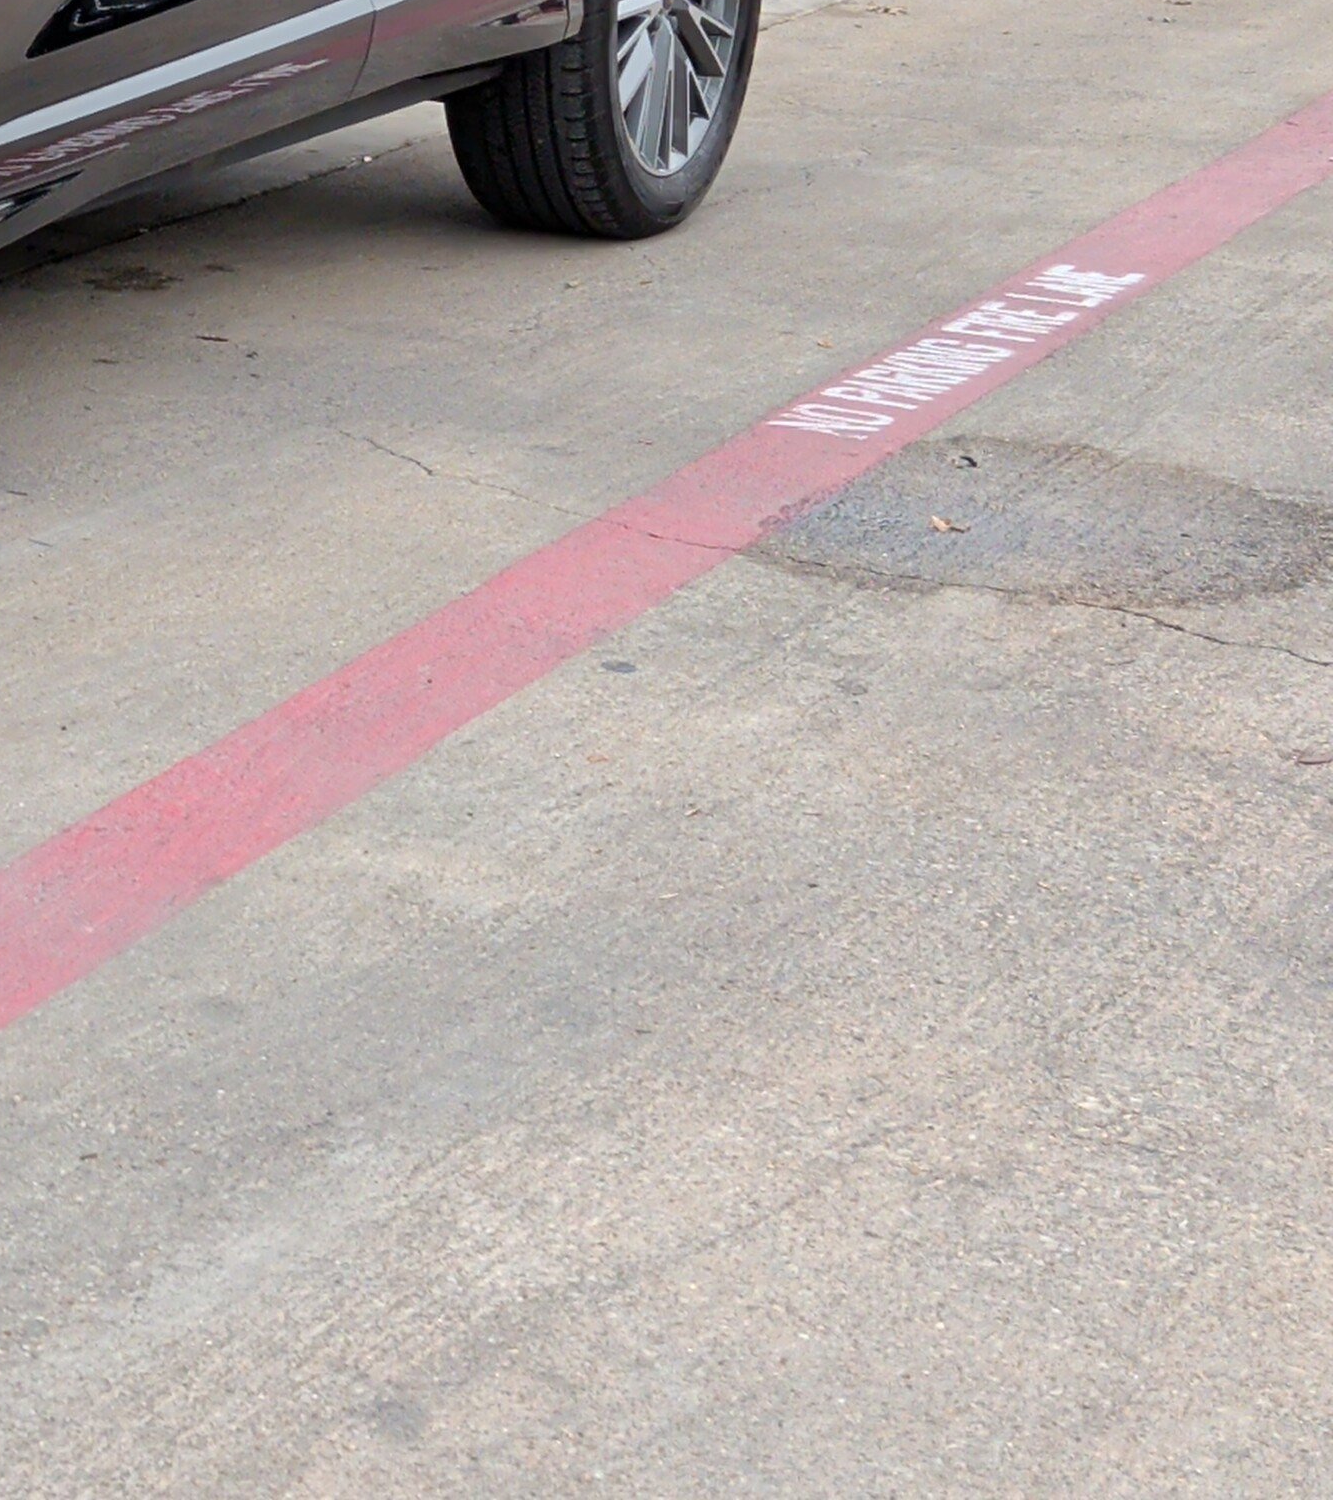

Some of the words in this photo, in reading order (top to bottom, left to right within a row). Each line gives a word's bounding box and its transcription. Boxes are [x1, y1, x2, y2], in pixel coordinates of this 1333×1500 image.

[1004, 263, 1147, 308] LANE
[941, 300, 1080, 343] FIRE
[819, 337, 1015, 411] PARKING
[765, 402, 895, 440] NO
